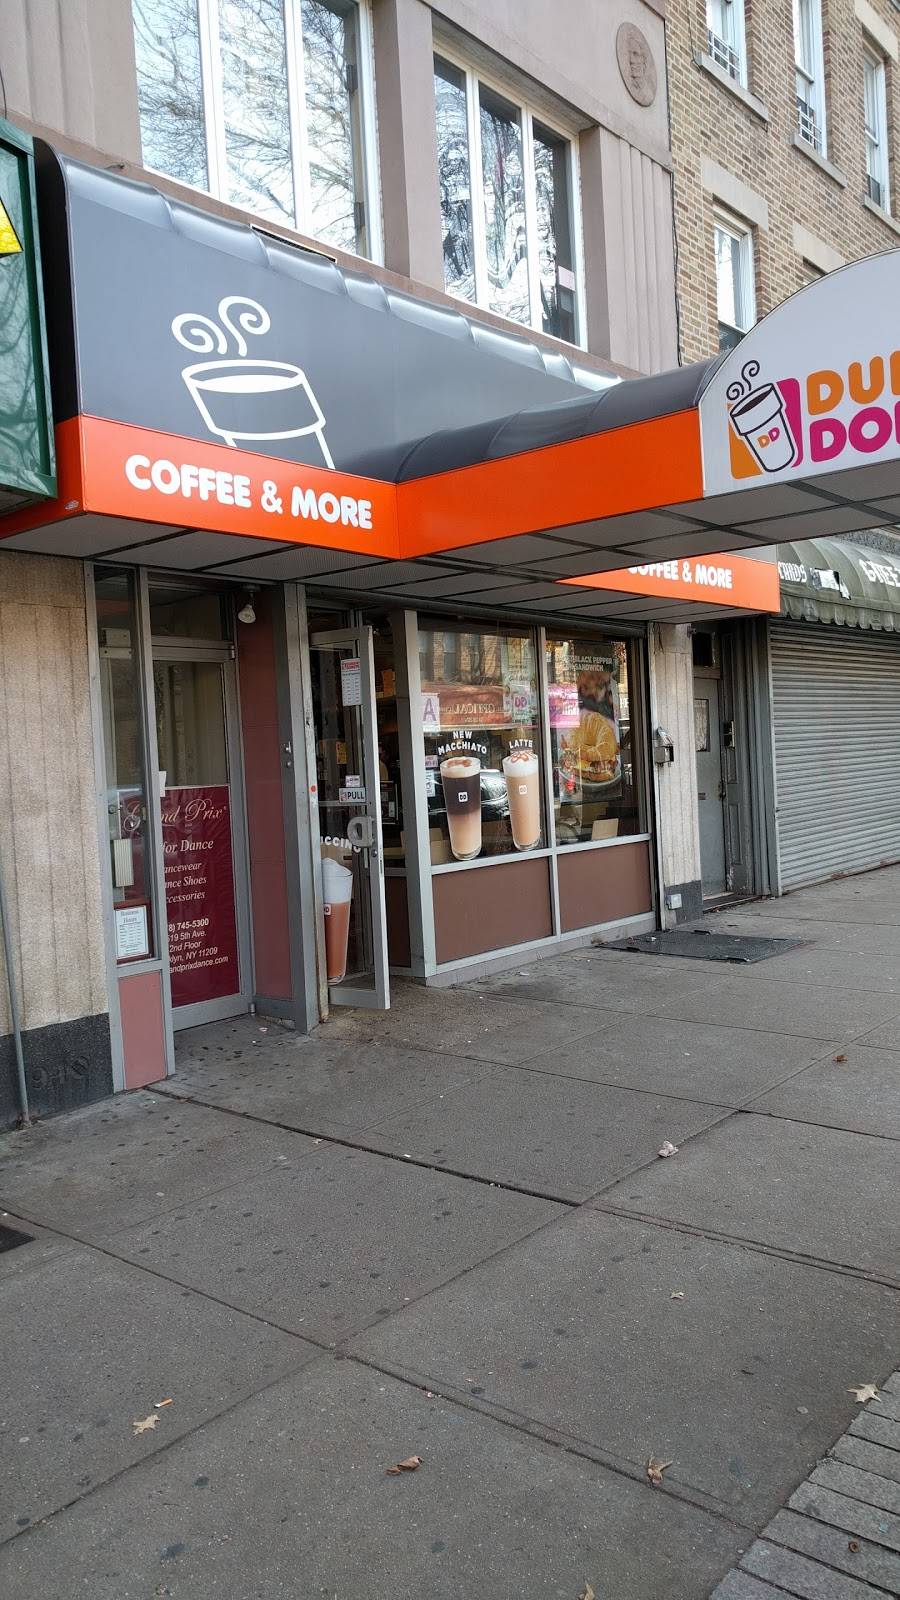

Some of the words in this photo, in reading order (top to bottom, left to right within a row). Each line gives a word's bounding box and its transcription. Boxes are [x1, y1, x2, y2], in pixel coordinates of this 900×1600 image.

[806, 351, 900, 415] DU
[757, 427, 780, 448] DD
[809, 400, 900, 463] DO
[125, 455, 251, 508] COFFEE
[261, 480, 283, 514] &
[291, 485, 373, 530] MORE
[682, 561, 692, 583] &
[695, 563, 733, 589] MORE
[422, 698, 437, 721] A
[453, 730, 473, 740] NEW
[438, 740, 487, 755] MACCHIATO
[509, 738, 533, 749] LATTE
[347, 791, 365, 800] PULL
[180, 839, 214, 852] Dance
[183, 875, 207, 887] Shoes
[177, 918, 210, 930] 745-5300
[180, 931, 191, 941] 5th
[191, 930, 207, 938] Ave.
[169, 942, 183, 953] 2nd
[183, 941, 202, 950] Floor
[185, 950, 197, 960] NY
[198, 946, 218, 957] 11209
